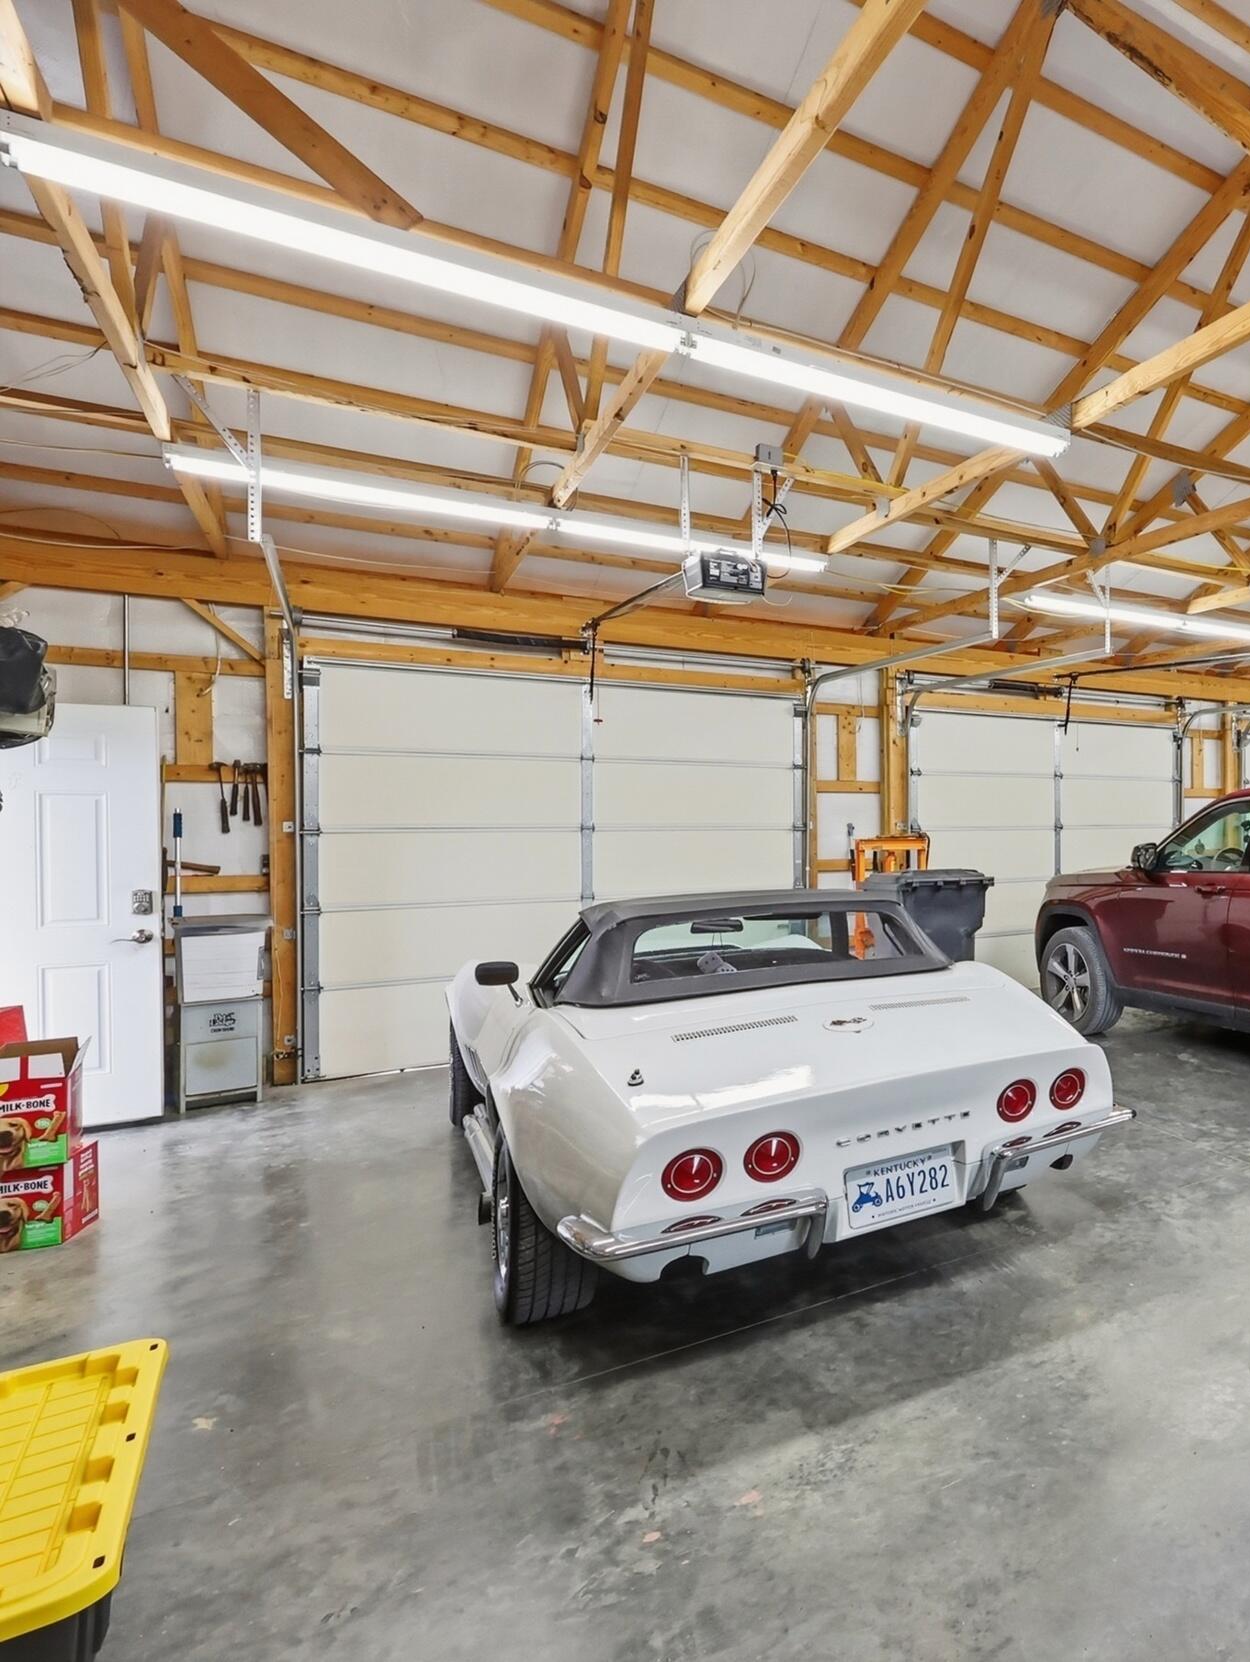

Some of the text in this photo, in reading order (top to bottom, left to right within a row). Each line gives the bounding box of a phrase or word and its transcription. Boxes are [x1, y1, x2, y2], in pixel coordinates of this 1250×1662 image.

[836, 1111, 970, 1147] CORVETTE
[873, 1157, 926, 1177] KENTUCKY
[885, 1164, 950, 1203] A6Y282
